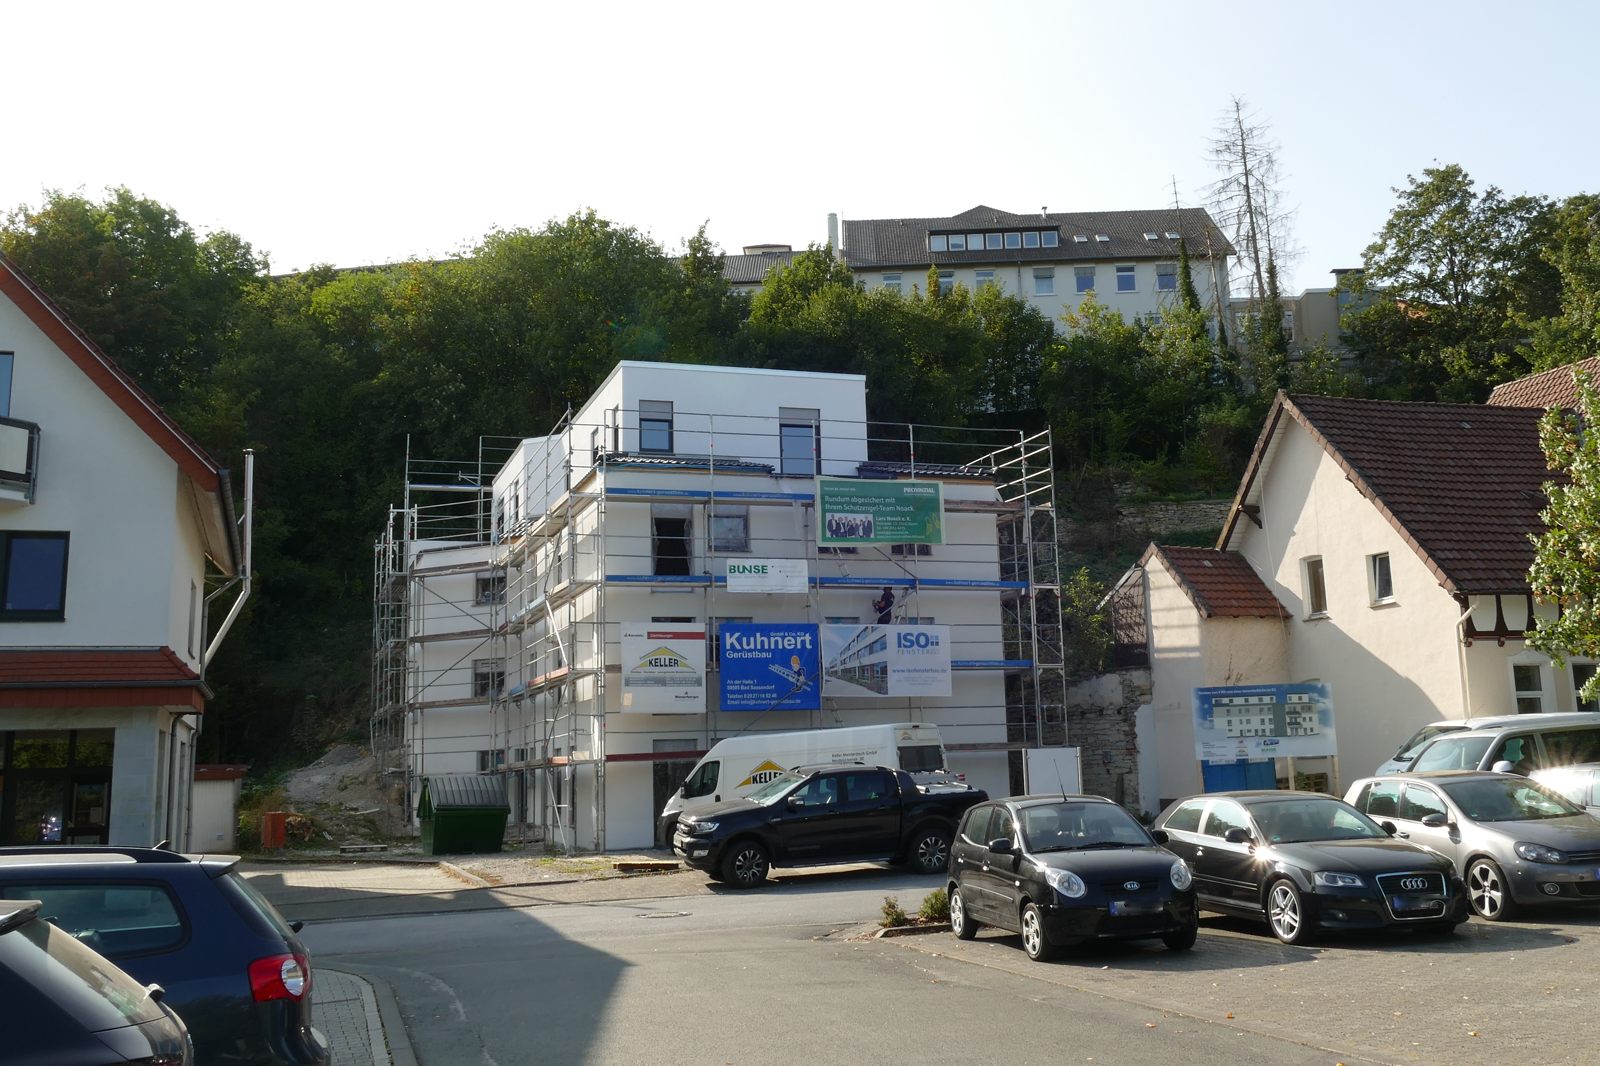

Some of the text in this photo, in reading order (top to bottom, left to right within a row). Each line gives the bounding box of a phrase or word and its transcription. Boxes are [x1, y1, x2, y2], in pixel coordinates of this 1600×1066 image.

[843, 504, 896, 512] Schutzengel-Team
[728, 565, 768, 574] BUNSE
[725, 632, 813, 650] Kuhnert
[897, 632, 930, 648] ISO
[726, 650, 772, 658] Gerüstbau
[648, 657, 679, 667] KELLER
